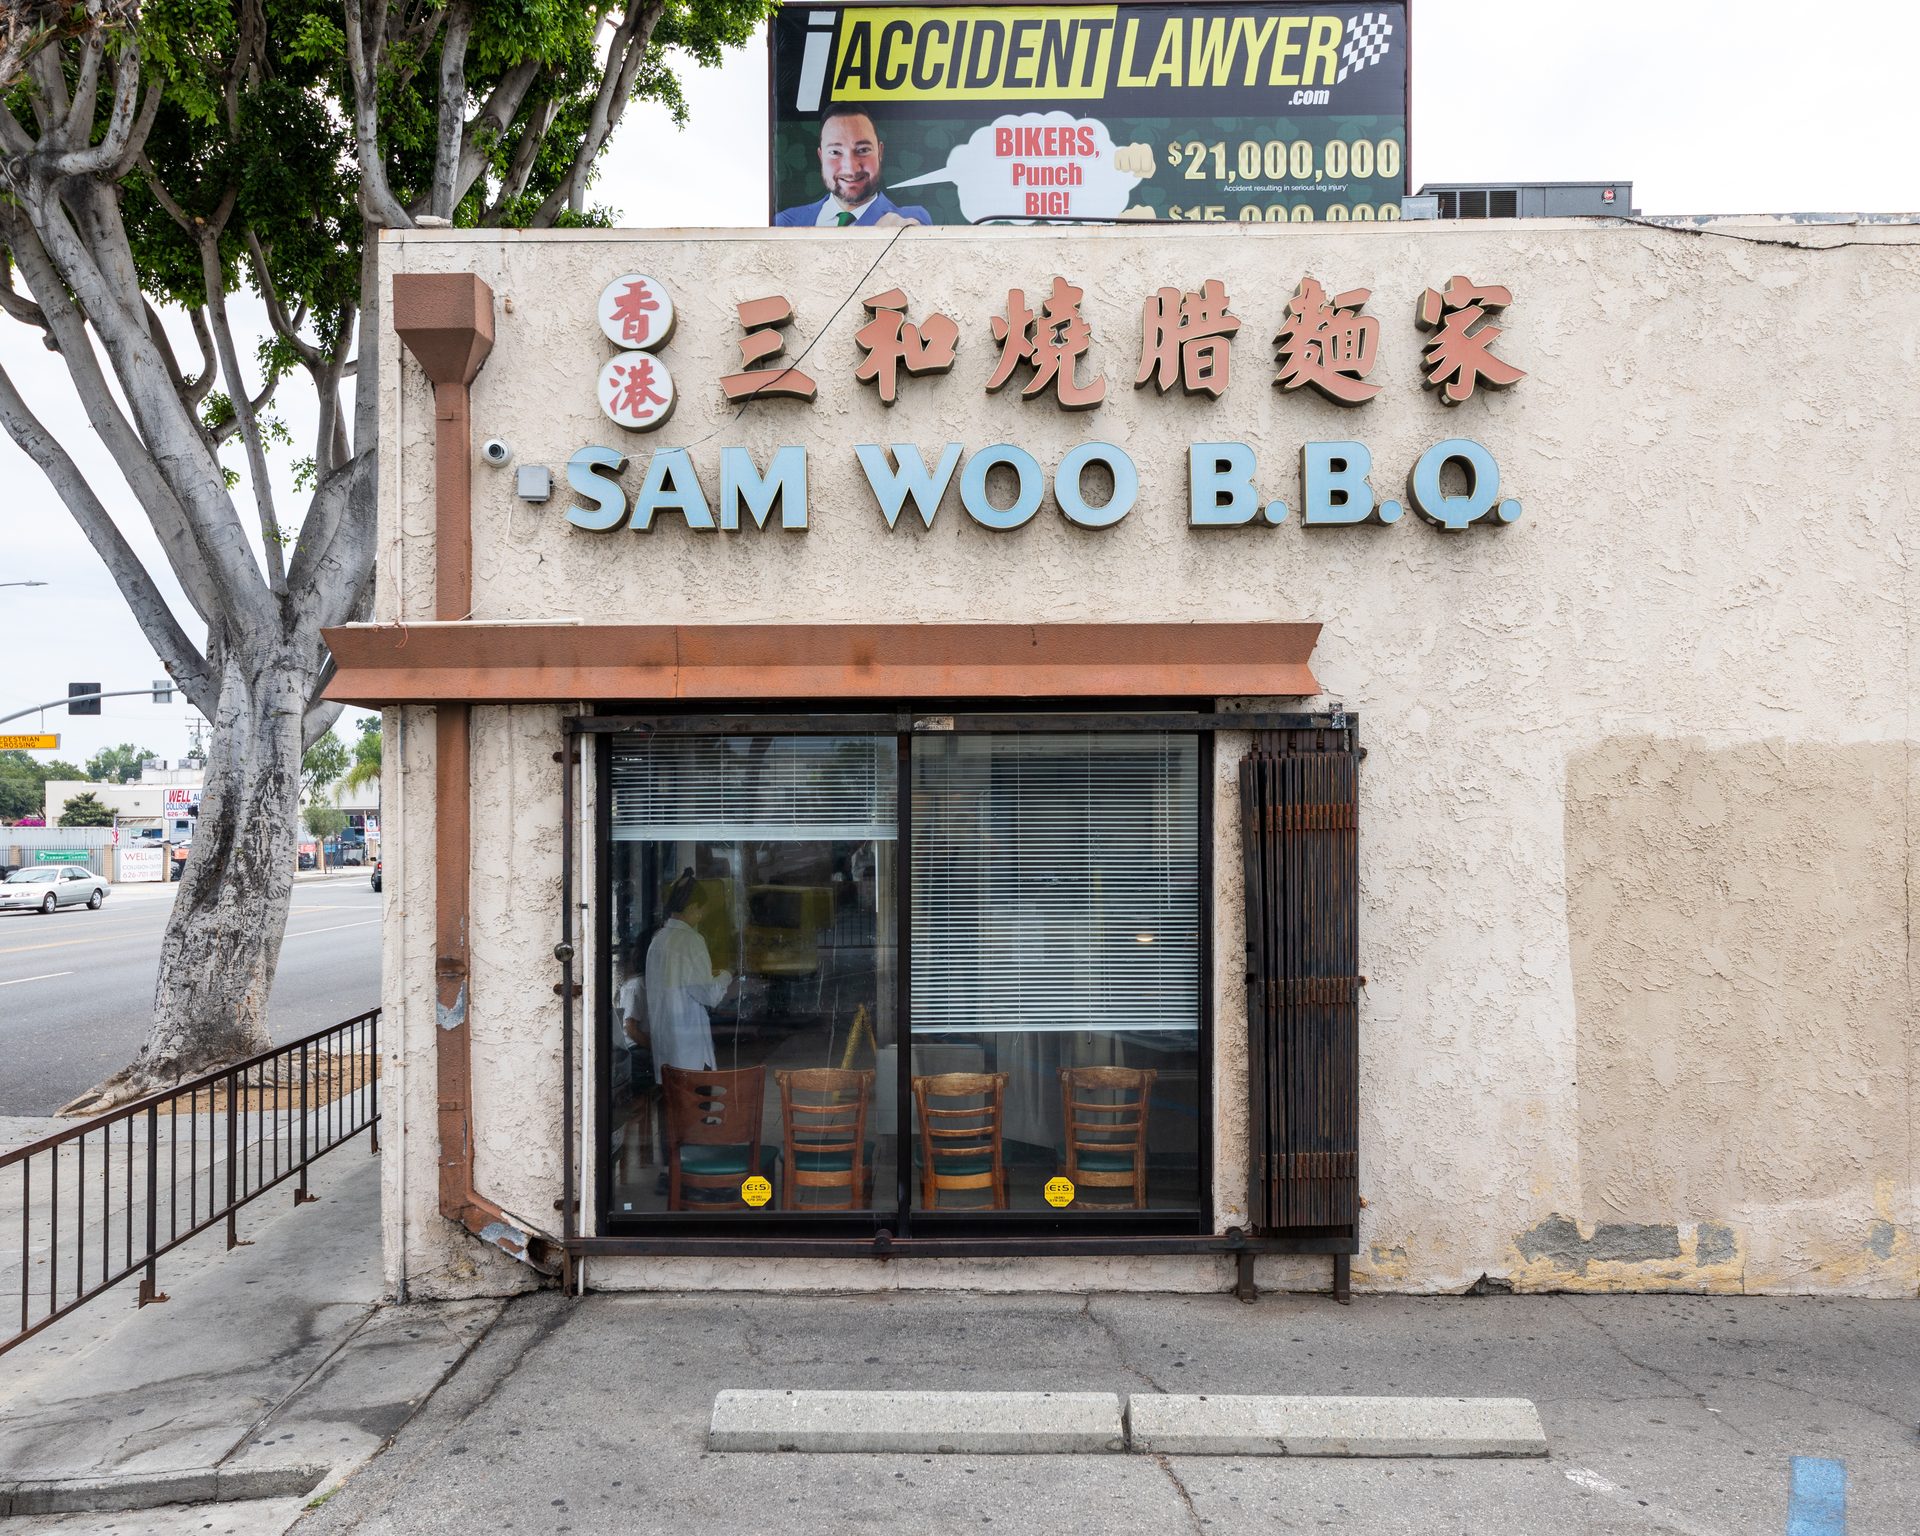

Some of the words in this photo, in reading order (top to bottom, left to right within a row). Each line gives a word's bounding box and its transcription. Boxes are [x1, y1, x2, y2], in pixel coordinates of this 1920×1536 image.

[1288, 89, 1330, 106] .com
[995, 126, 1100, 158] BIKERS,
[1167, 138, 1401, 184] $21,000,000
[1012, 162, 1083, 186] Punch
[1223, 184, 1252, 192] Accident
[1253, 184, 1282, 193] resulting
[1316, 184, 1327, 193] leg
[1025, 191, 1070, 215] BIG!
[608, 280, 668, 419] 香港
[564, 444, 809, 531] SAM
[853, 440, 1139, 530] WOO
[168, 790, 191, 803] WELL
[125, 852, 147, 861] WELL
